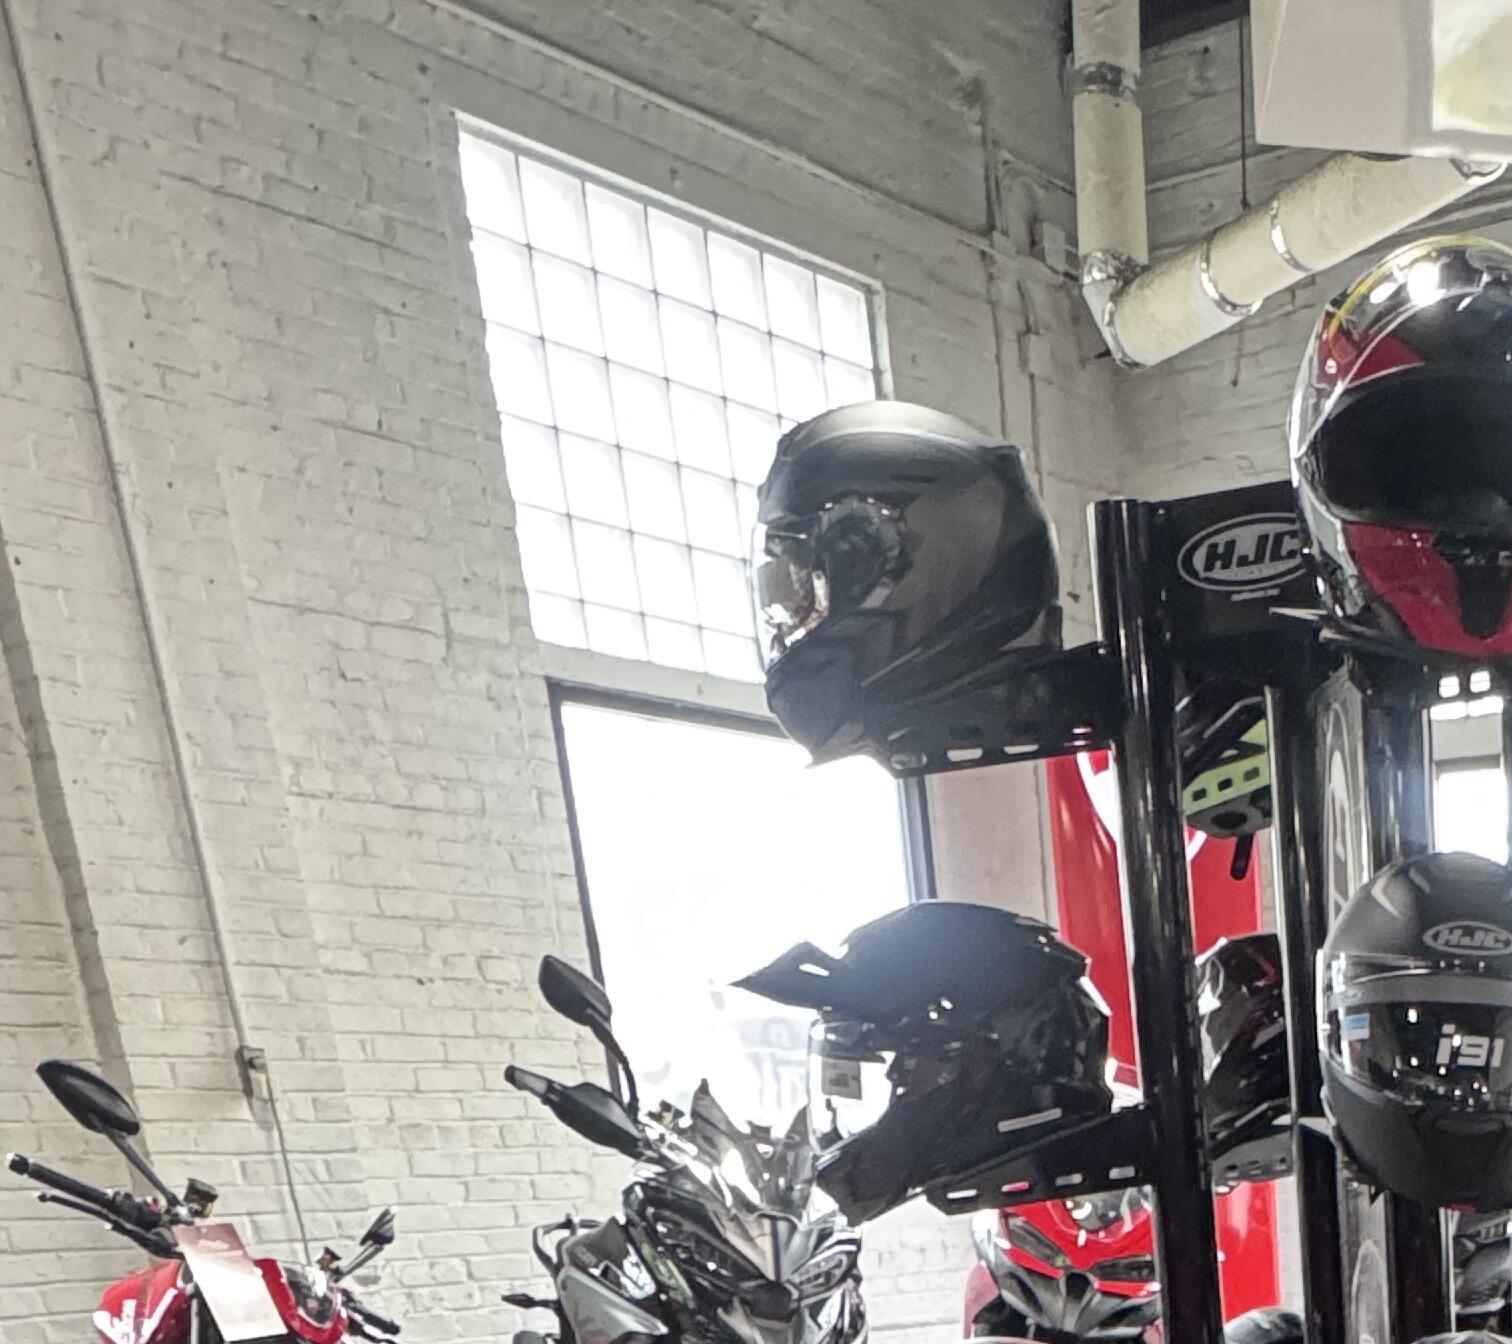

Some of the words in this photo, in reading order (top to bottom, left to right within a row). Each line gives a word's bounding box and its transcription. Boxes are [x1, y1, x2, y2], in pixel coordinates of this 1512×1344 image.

[1203, 529, 1300, 573] HJC
[1436, 928, 1508, 950] HJC
[1436, 1023, 1504, 1069] i91
